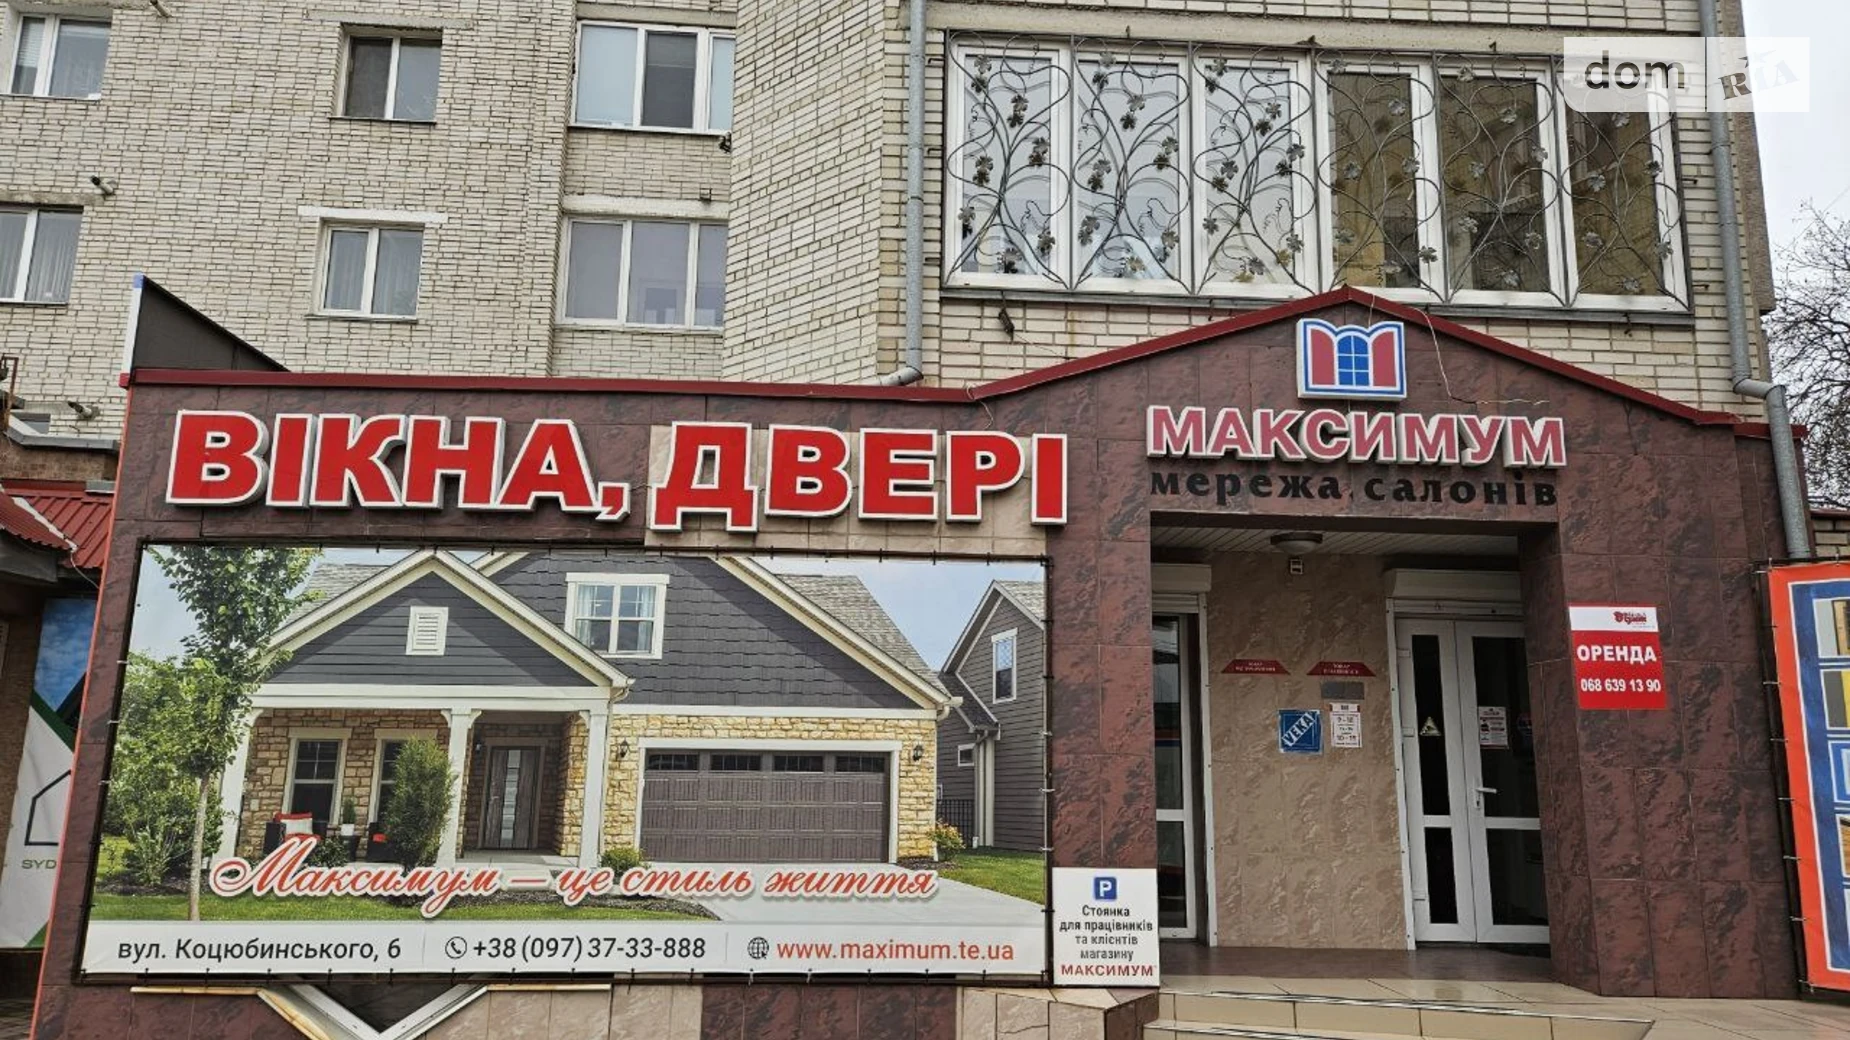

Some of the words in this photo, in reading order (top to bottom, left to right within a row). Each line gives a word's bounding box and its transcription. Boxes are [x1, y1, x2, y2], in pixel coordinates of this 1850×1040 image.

[1147, 405, 1567, 467] МАКСИМУМ
[166, 409, 631, 522] ВІКНА,
[649, 421, 1067, 533] ДВЕРІ
[1150, 469, 1342, 506] мережа
[1364, 472, 1557, 506] салонів
[1576, 645, 1657, 666] ОРЕНДА
[1580, 678, 1602, 692] 068
[1605, 679, 1626, 692] 639
[1629, 679, 1644, 692] 13
[1646, 679, 1662, 692] 90
[1282, 712, 1315, 745] VEKA
[22, 859, 57, 869] SYD
[211, 837, 500, 917] Максимум
[556, 867, 609, 904] це
[623, 868, 752, 893] стиль
[763, 869, 936, 895] життя
[1099, 880, 1112, 897] P
[1081, 905, 1130, 917] Стоянка
[1059, 921, 1081, 932] для
[1084, 919, 1153, 933] працівників
[473, 937, 517, 958] +38
[522, 935, 582, 962] (097)
[587, 937, 706, 959] 37-33-888
[777, 939, 1014, 960] www.maximum.te.ua
[1075, 935, 1088, 945] та
[1091, 933, 1138, 945] клієнтів
[118, 942, 166, 963] вул.
[175, 937, 379, 963] Коцюбинського,
[387, 937, 401, 959] 6
[1080, 949, 1134, 961] магазину
[1061, 965, 1154, 976] МАКСИМУМ
